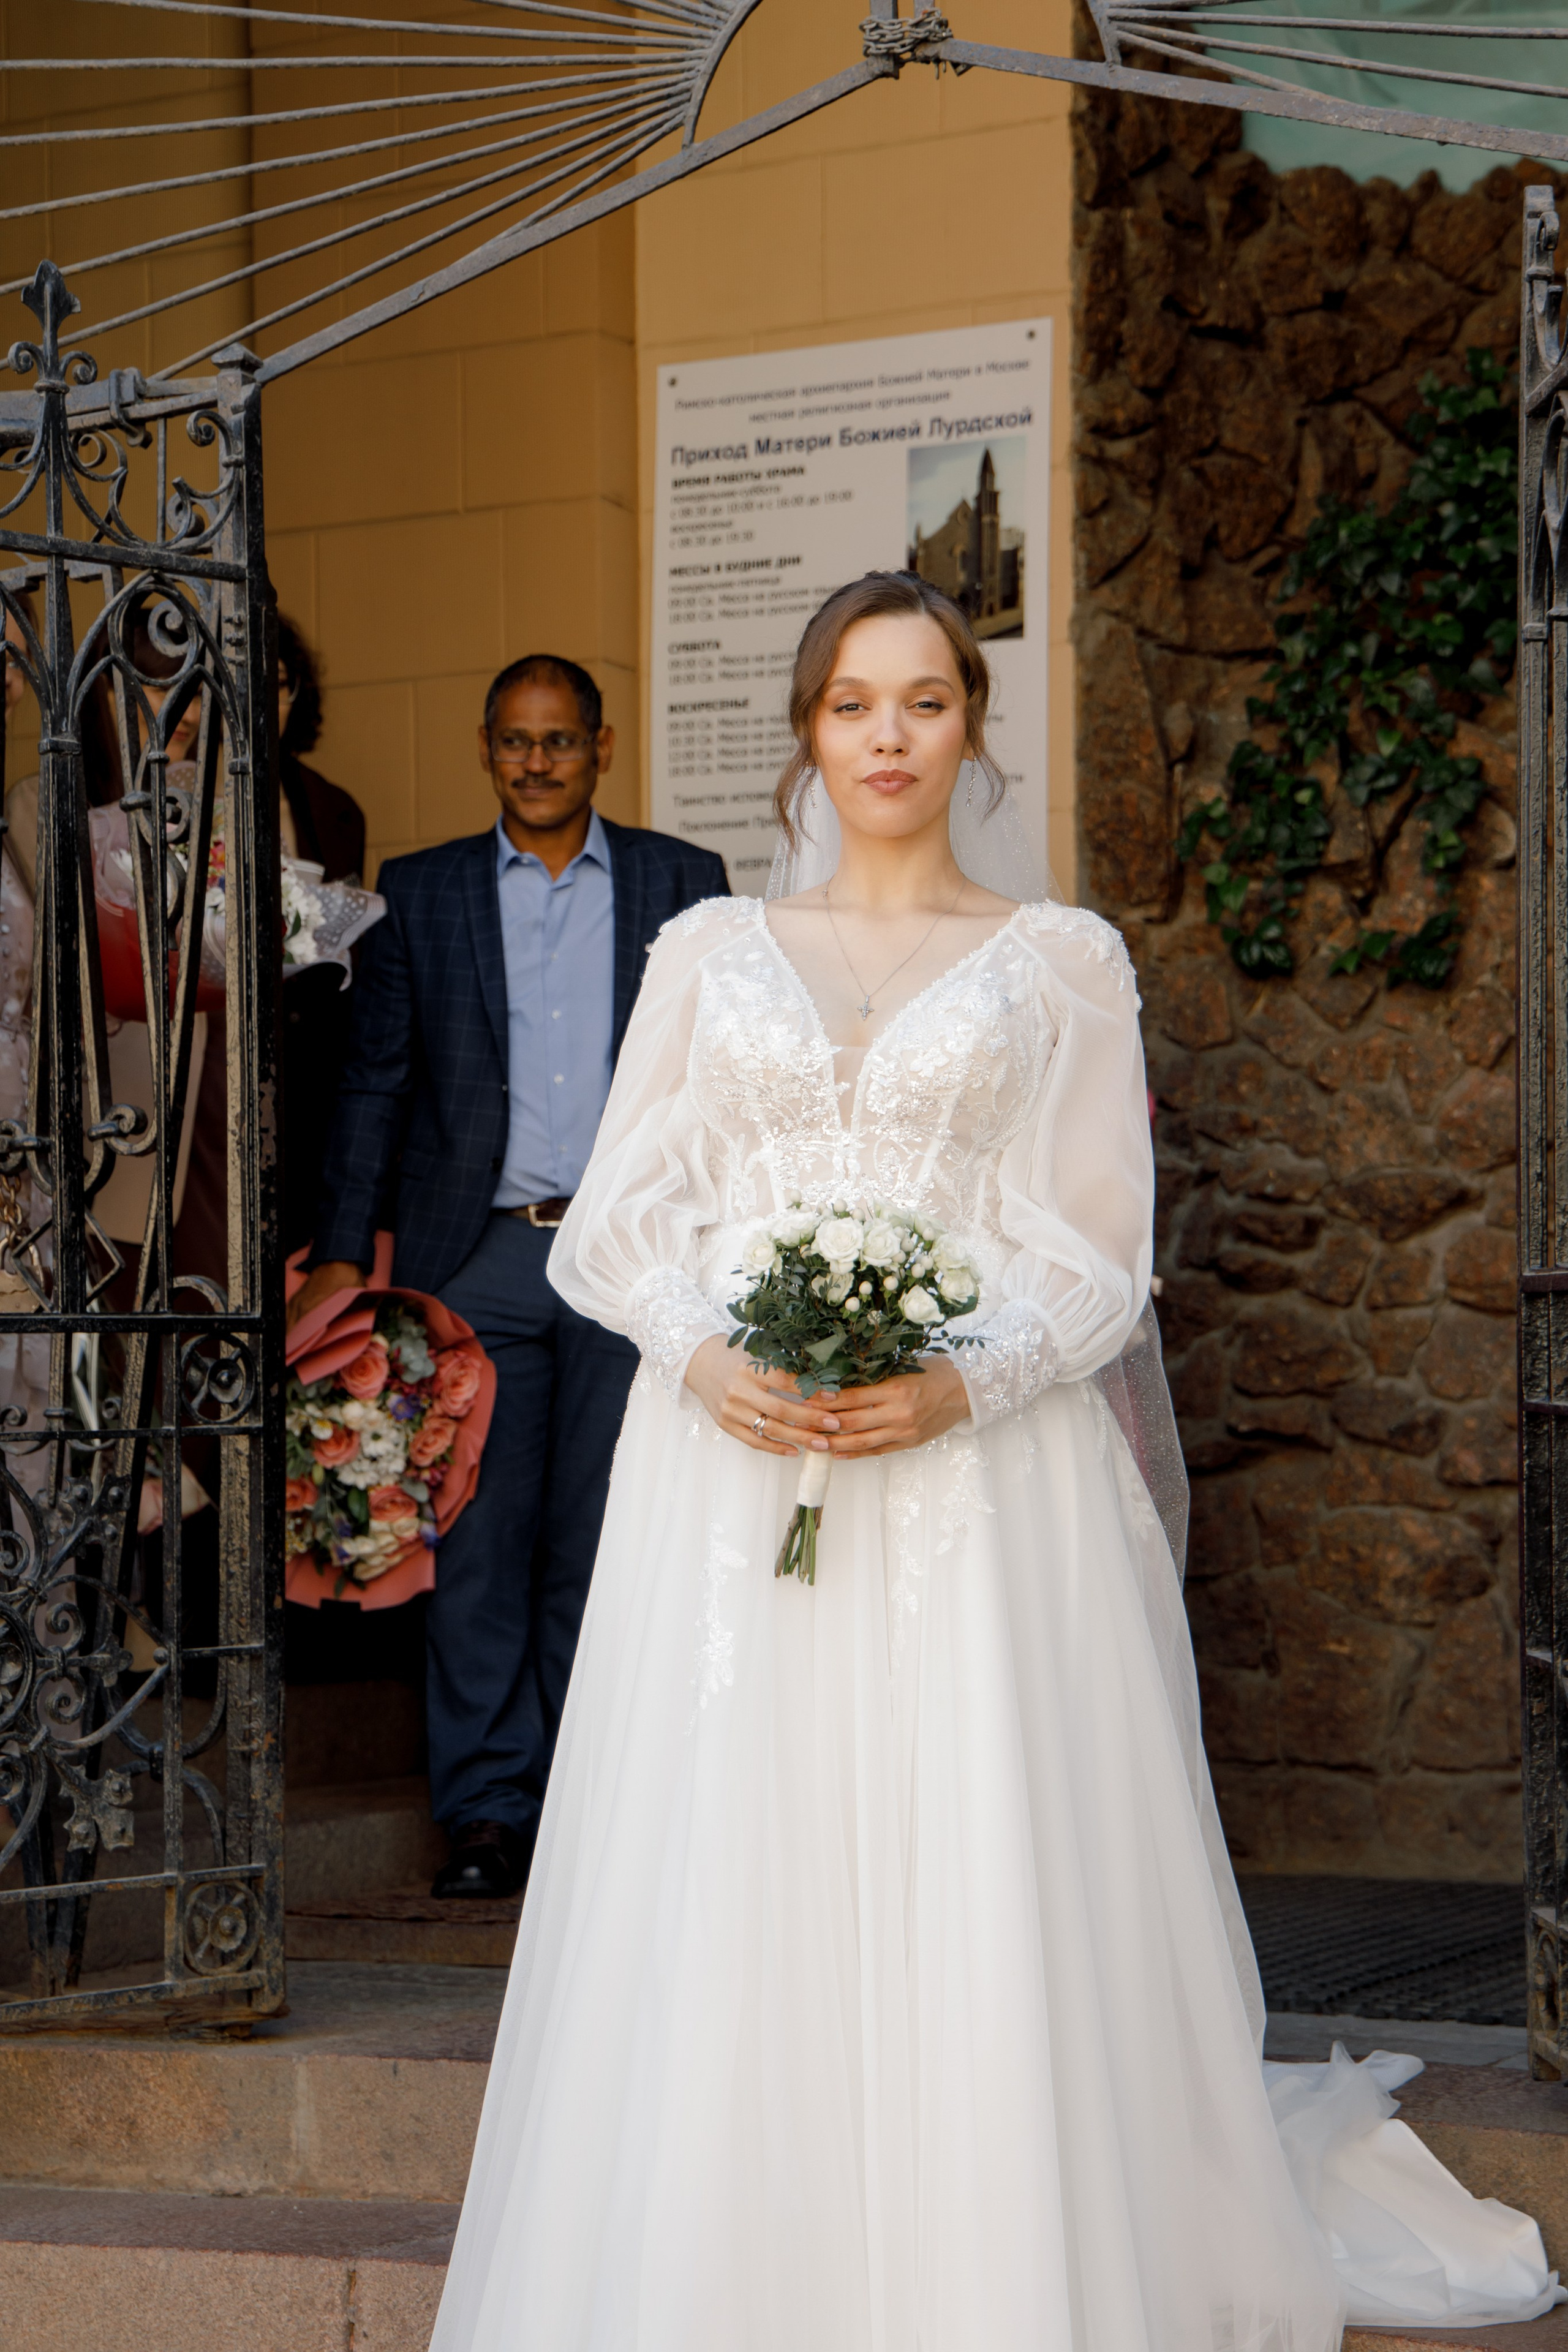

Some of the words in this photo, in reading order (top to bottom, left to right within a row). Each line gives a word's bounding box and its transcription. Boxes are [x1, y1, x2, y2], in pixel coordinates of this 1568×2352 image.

[878, 371, 921, 385] Божией
[927, 368, 970, 379] Матери
[986, 360, 1030, 372] Москве
[876, 391, 949, 408] организация
[671, 444, 747, 467] Приход
[755, 436, 831, 455] Матери
[839, 420, 921, 446] Божией
[929, 407, 1032, 440] Лурдской
